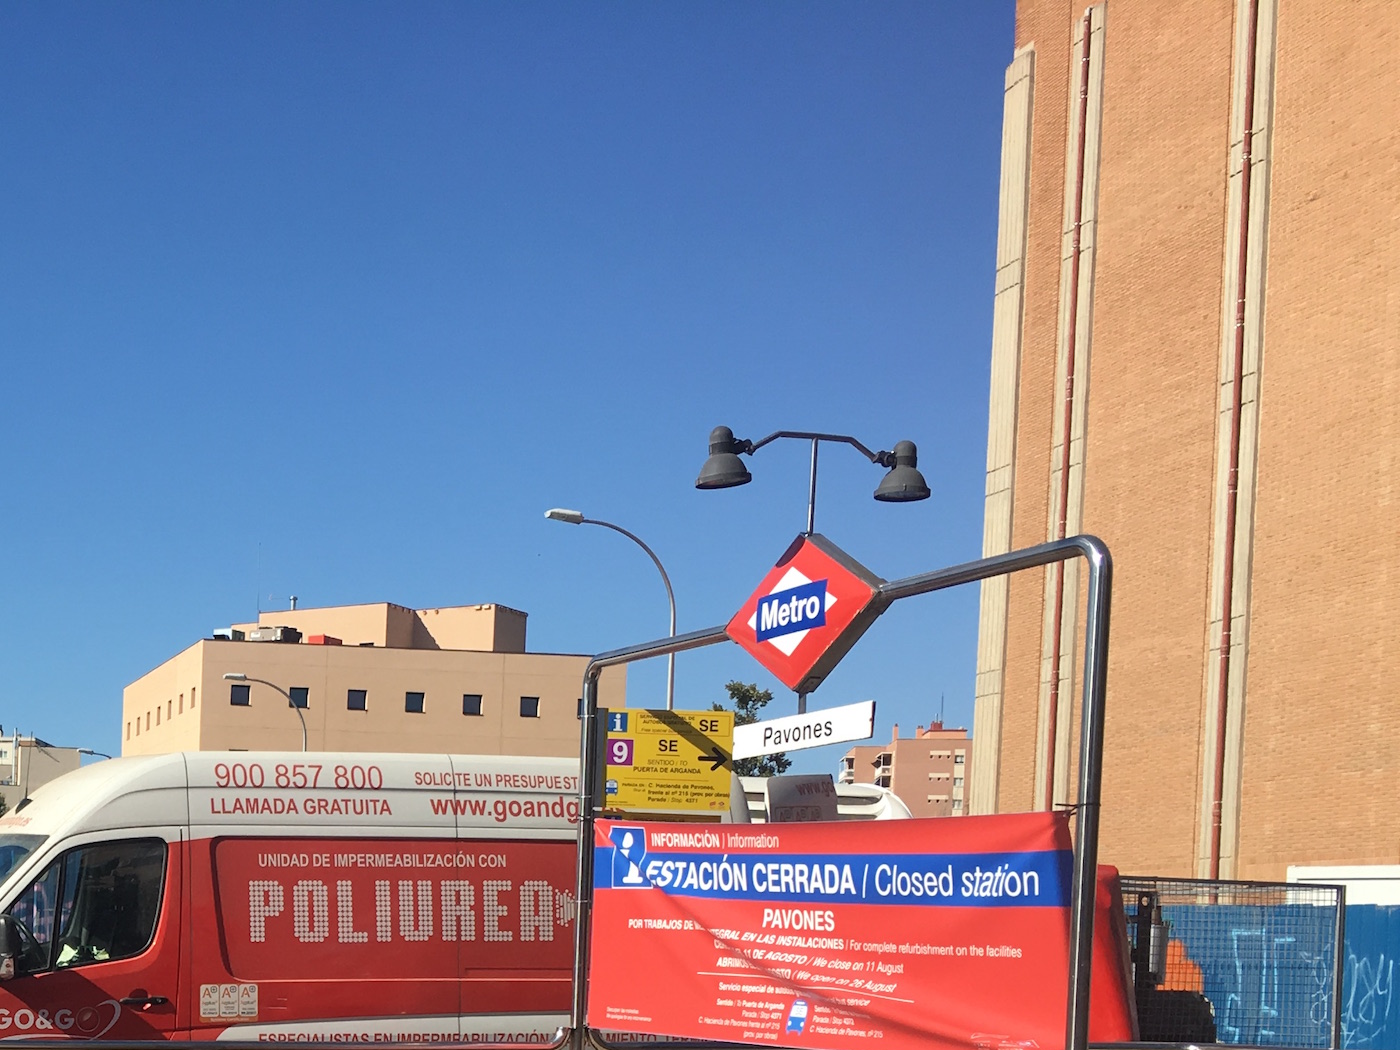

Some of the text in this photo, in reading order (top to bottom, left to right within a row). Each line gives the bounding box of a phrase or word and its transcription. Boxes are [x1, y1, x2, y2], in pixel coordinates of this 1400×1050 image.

[760, 595, 820, 632] Metro
[699, 719, 719, 732] SE
[763, 720, 833, 748] Pavones
[612, 741, 628, 763] 9
[658, 739, 678, 752] SE
[214, 763, 383, 791] 900 857 800
[415, 771, 578, 791] SOLICITE UN PRESUPUEST
[210, 797, 392, 816] LLAMADA GRATUITA
[651, 830, 779, 848] INFORMACIÓN Information
[257, 851, 506, 868] UNIDAD DE IMPERMEABILIZACIÓN CON
[646, 854, 748, 892] ESTACIÓN
[752, 863, 857, 894] CERRADA
[874, 864, 953, 897] Closed
[961, 863, 1039, 897] station
[248, 880, 554, 942] POLIUREA
[762, 908, 835, 932] PAVONES
[628, 919, 643, 928] POR
[644, 919, 682, 930] TRABAJOS
[683, 920, 694, 930] DE
[741, 931, 757, 941] EN
[756, 933, 776, 944] LAS
[776, 935, 844, 950] INSTALACIONES
[850, 939, 861, 951] For
[863, 941, 897, 954] complete
[899, 943, 954, 956] refurbishment
[955, 945, 968, 956] on
[970, 944, 984, 957] the
[986, 945, 1022, 958] facilities
[752, 948, 766, 959] DE
[764, 950, 808, 965] AGOSTO
[812, 956, 828, 968] We
[827, 958, 852, 970] close
[852, 961, 864, 971] on
[866, 961, 875, 972] 11
[876, 961, 904, 976] August
[718, 982, 775, 994] Servicio especial de
[796, 970, 811, 980] We
[810, 974, 836, 983] open
[835, 978, 850, 986] on
[849, 978, 865, 988] 26
[862, 980, 897, 993] August
[716, 998, 734, 1006] Sentido
[742, 1000, 757, 1008] Puerta
[764, 1001, 785, 1010] Arganda
